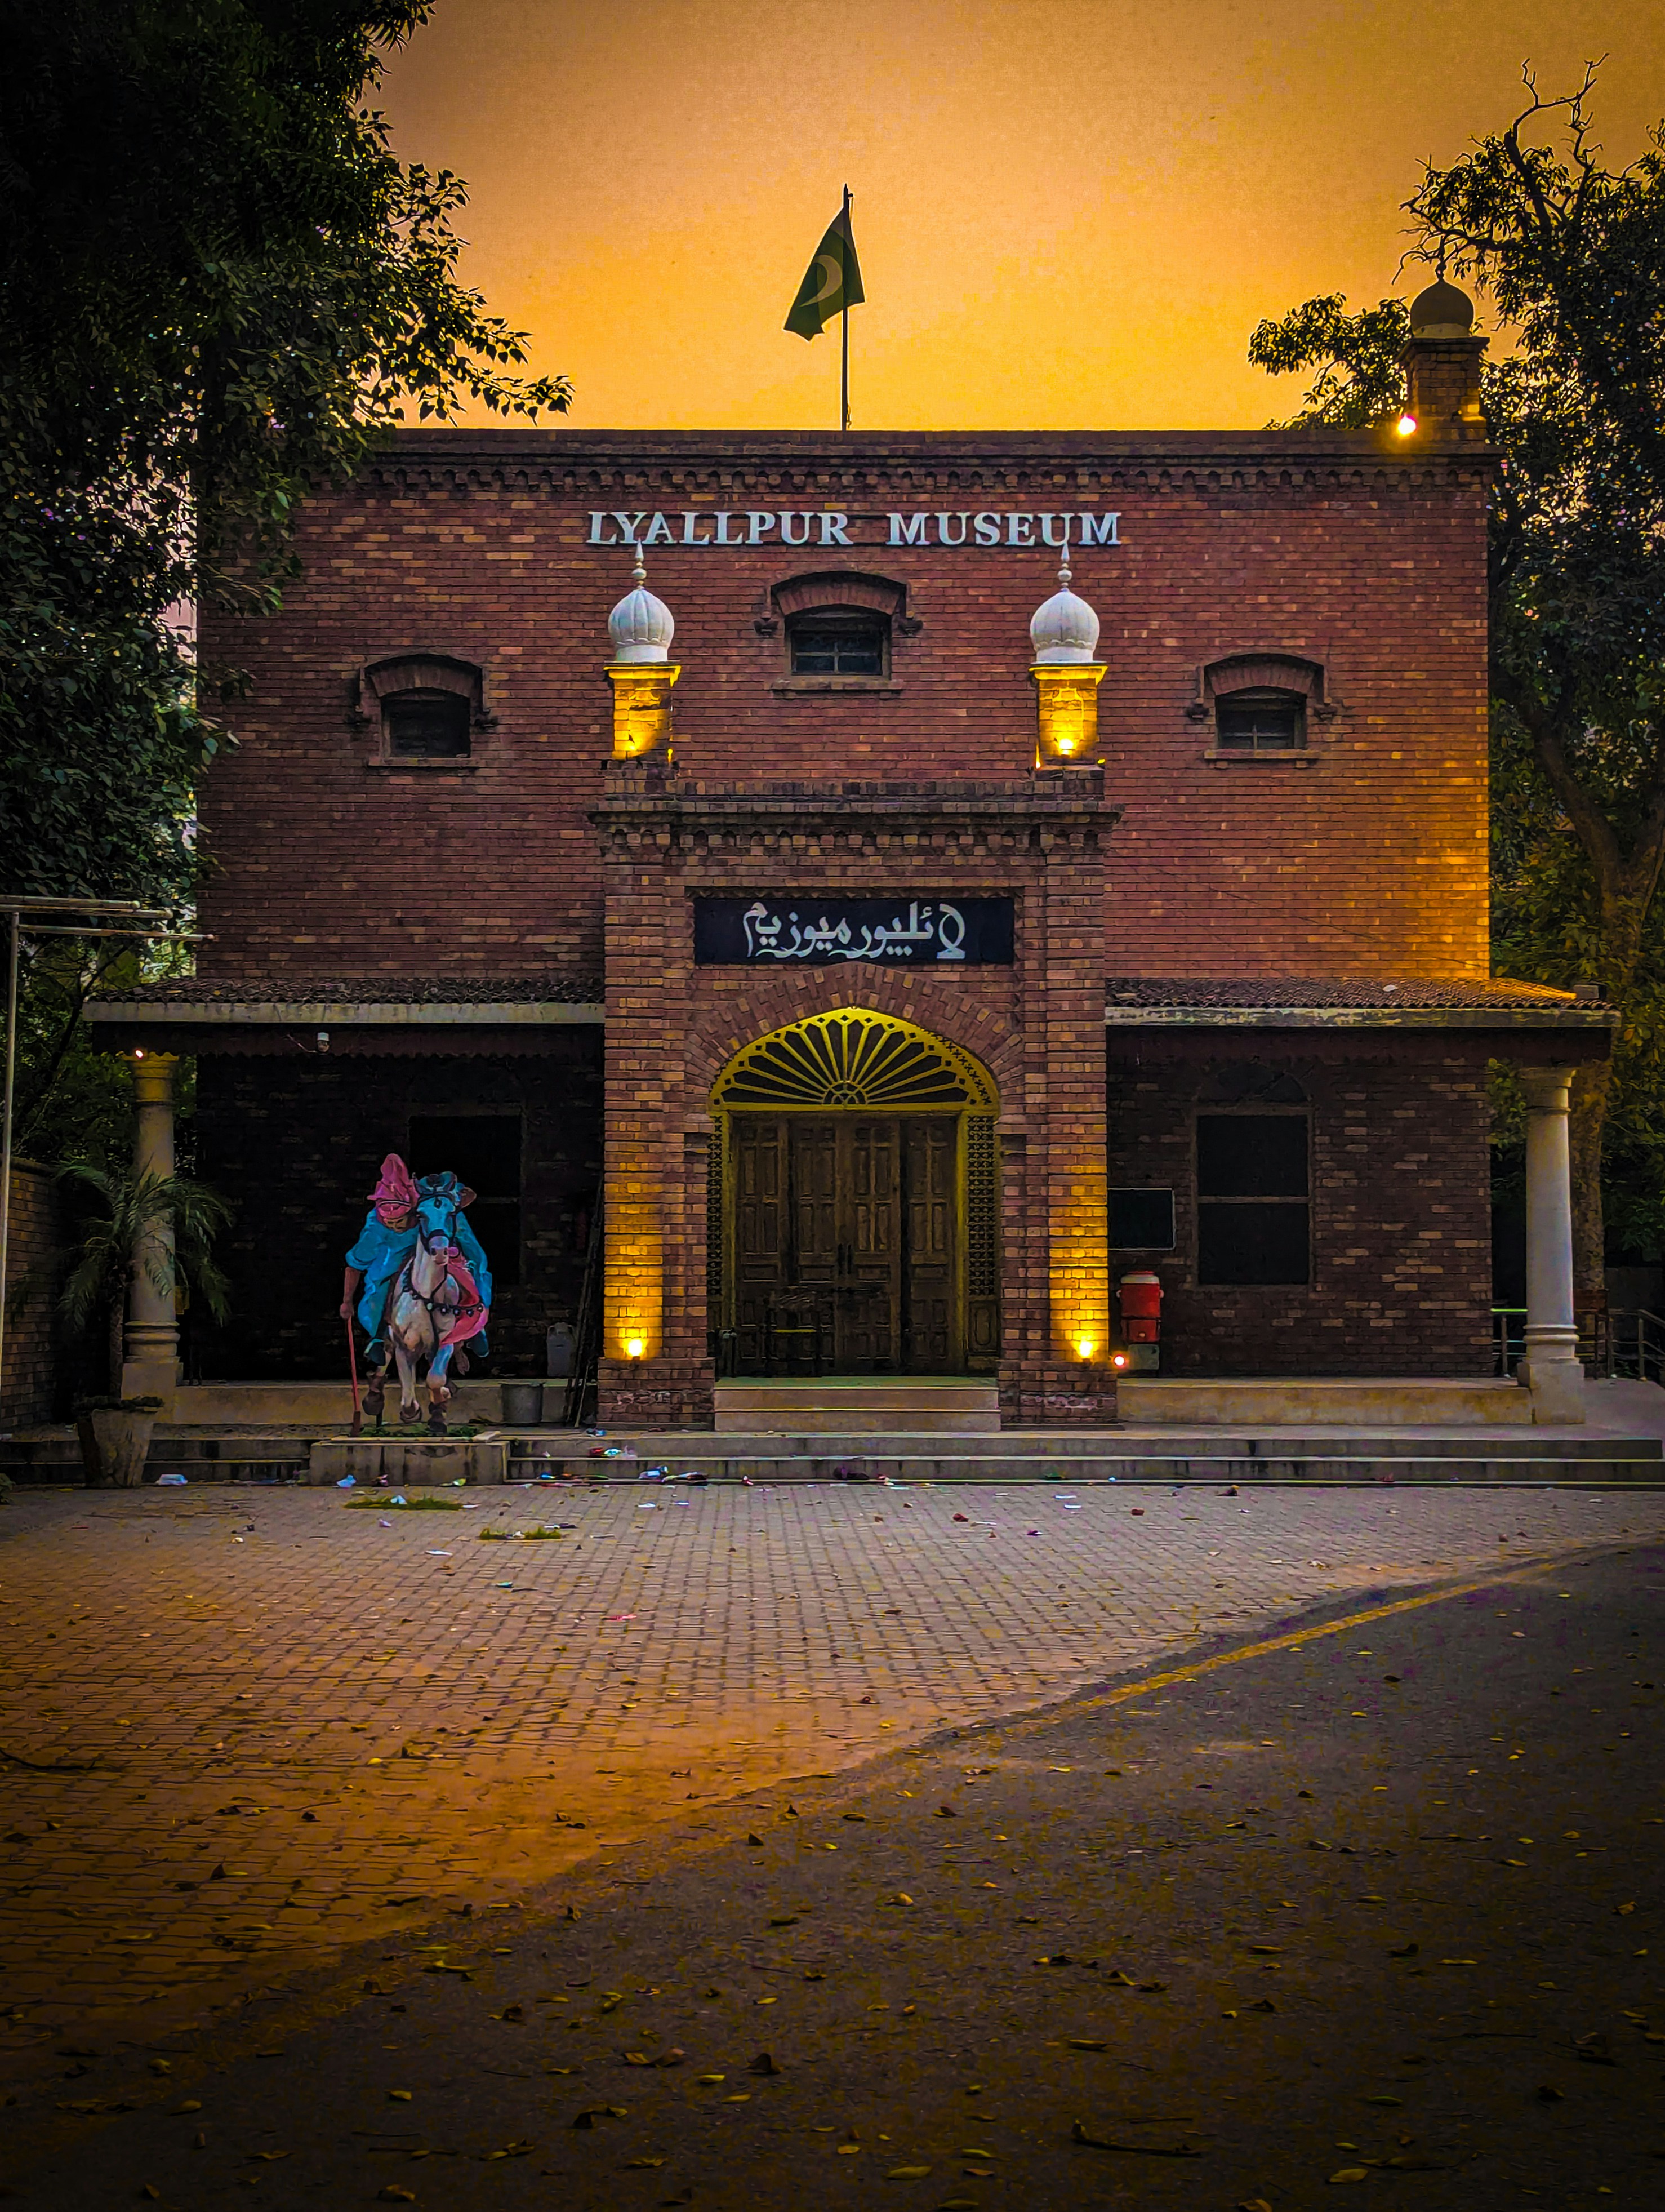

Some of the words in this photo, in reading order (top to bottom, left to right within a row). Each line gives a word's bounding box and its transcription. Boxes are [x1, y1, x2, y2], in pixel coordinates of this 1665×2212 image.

[587, 512, 854, 544] LYALLPUR
[887, 512, 1122, 546] MUSEUM
[742, 901, 851, 958] میوزیم
